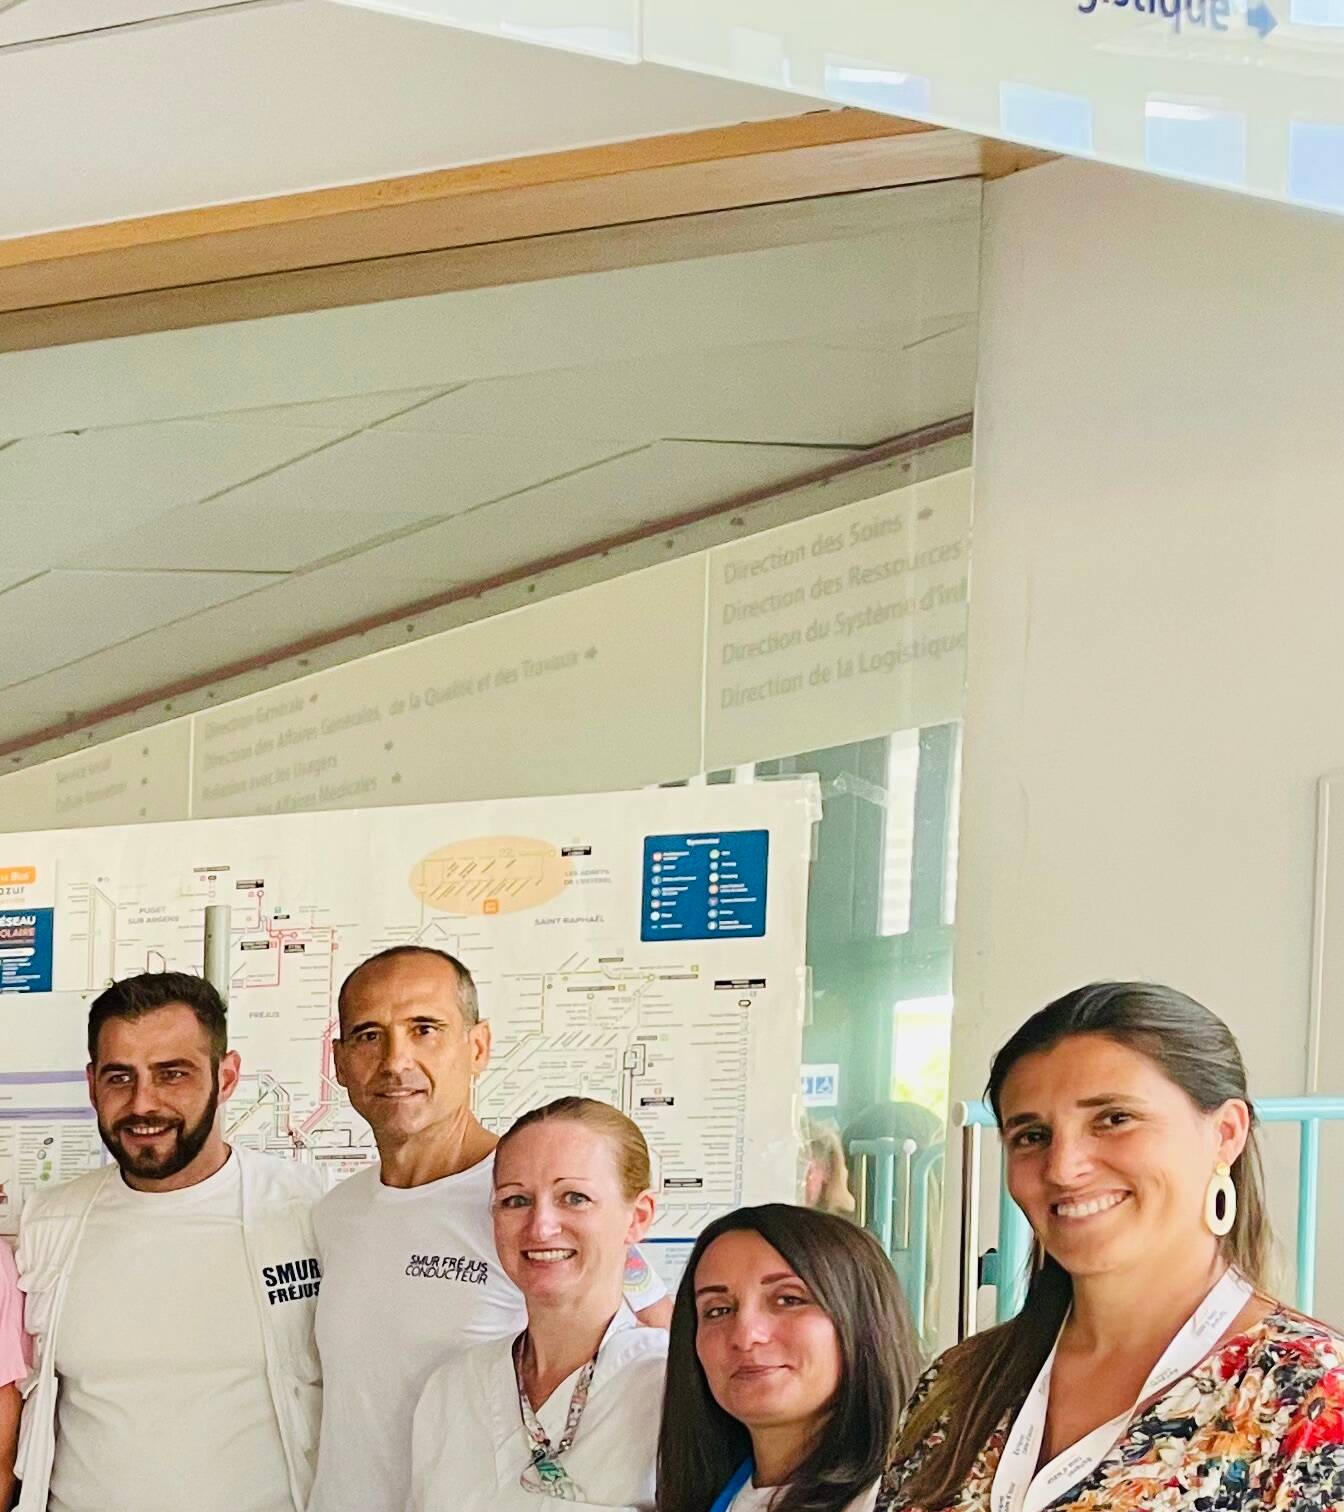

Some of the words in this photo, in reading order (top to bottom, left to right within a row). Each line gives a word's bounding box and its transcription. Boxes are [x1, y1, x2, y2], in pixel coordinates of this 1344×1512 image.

[723, 548, 806, 584] Direction
[812, 533, 843, 557] des
[849, 514, 903, 546] Soins
[722, 587, 806, 624] Direction
[811, 574, 843, 599] des
[848, 540, 962, 586] Ressources
[722, 629, 802, 665] Direction
[805, 617, 830, 642] du
[721, 671, 803, 709] Direction
[809, 662, 831, 686] de
[837, 657, 853, 678] la
[262, 1258, 322, 1287] SMUR
[405, 1264, 488, 1285] CONDUCTEUR
[409, 1254, 439, 1267] SMUR
[442, 1255, 488, 1272] FRÉJUS
[268, 1280, 321, 1305] FRÉJUS
